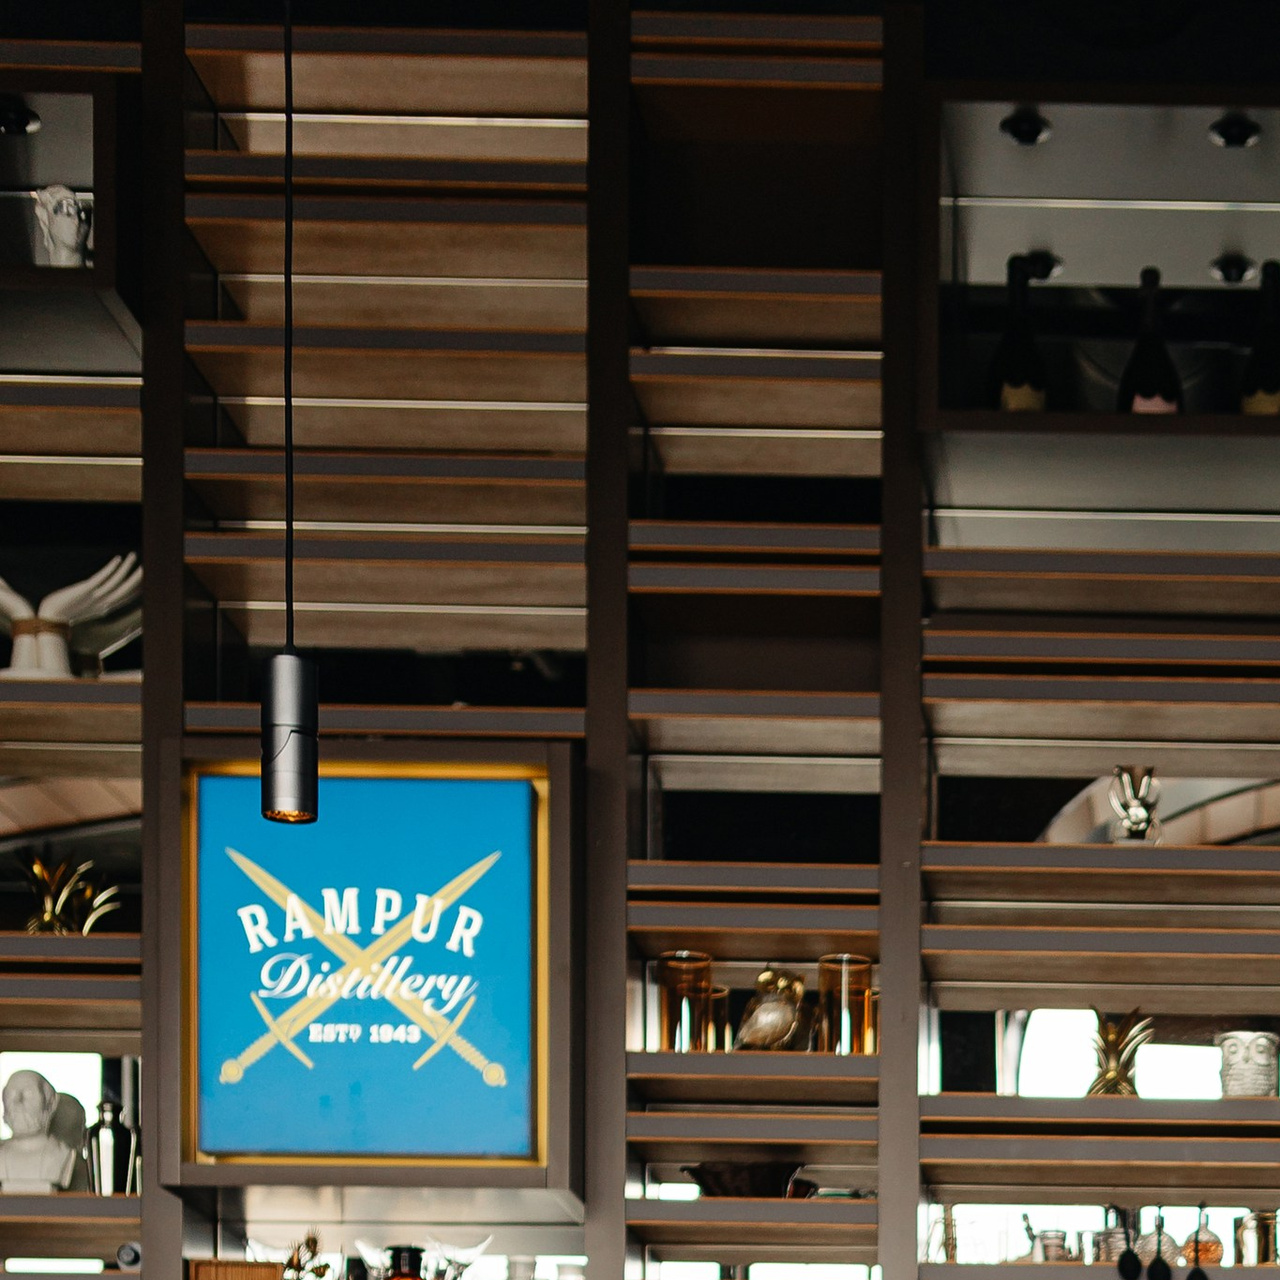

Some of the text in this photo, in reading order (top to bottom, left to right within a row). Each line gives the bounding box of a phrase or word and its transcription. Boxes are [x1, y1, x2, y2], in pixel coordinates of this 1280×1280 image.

[236, 887, 484, 958] RAMPUR
[258, 951, 478, 1017] Distillery
[369, 1024, 421, 1044] 1943
